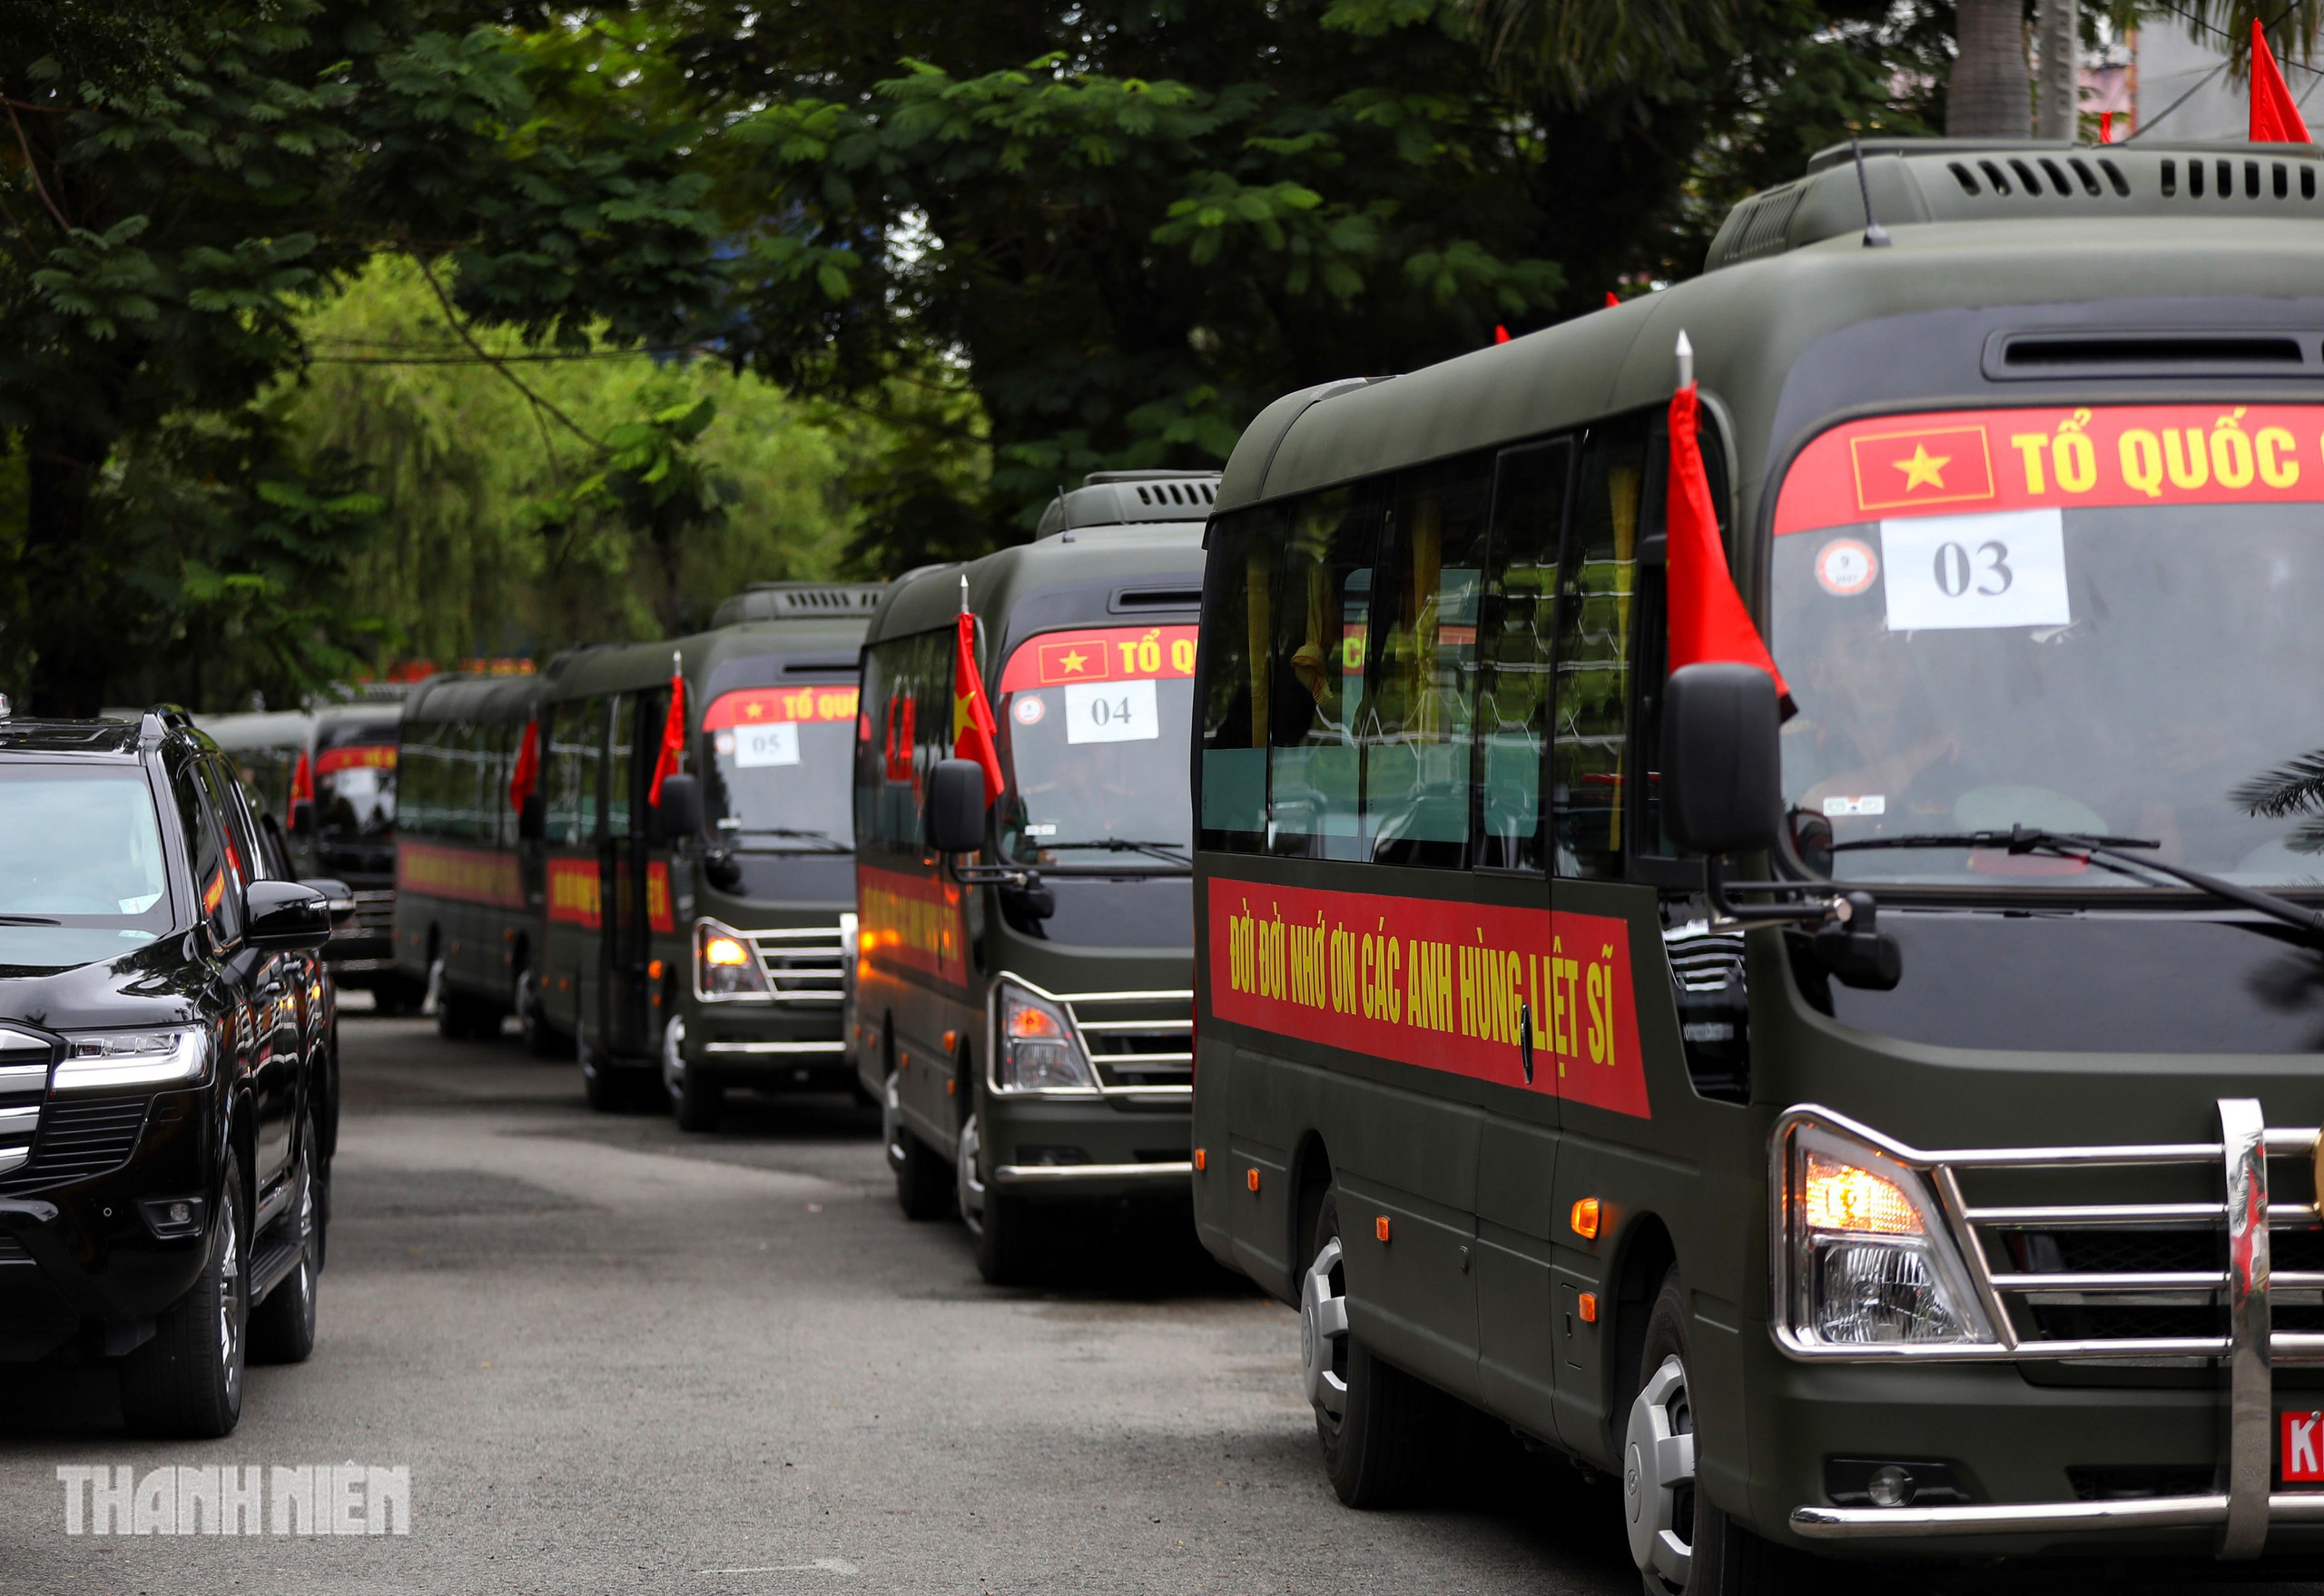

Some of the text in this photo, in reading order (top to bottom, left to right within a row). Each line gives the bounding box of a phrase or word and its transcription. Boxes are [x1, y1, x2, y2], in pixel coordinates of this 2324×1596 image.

[2011, 409, 2098, 495] TỔ
[2118, 408, 2300, 498] QUỐC
[1933, 541, 2014, 597] 03
[1118, 628, 1198, 675] TỔ Q
[1091, 697, 1131, 725] 04
[752, 734, 781, 755] 05
[1229, 898, 1616, 1078] ĐỜI ĐỜI NHỚ ƠN CÁC ANH HÙNG LIỆT SĨ
[2290, 1419, 2324, 1473] K
